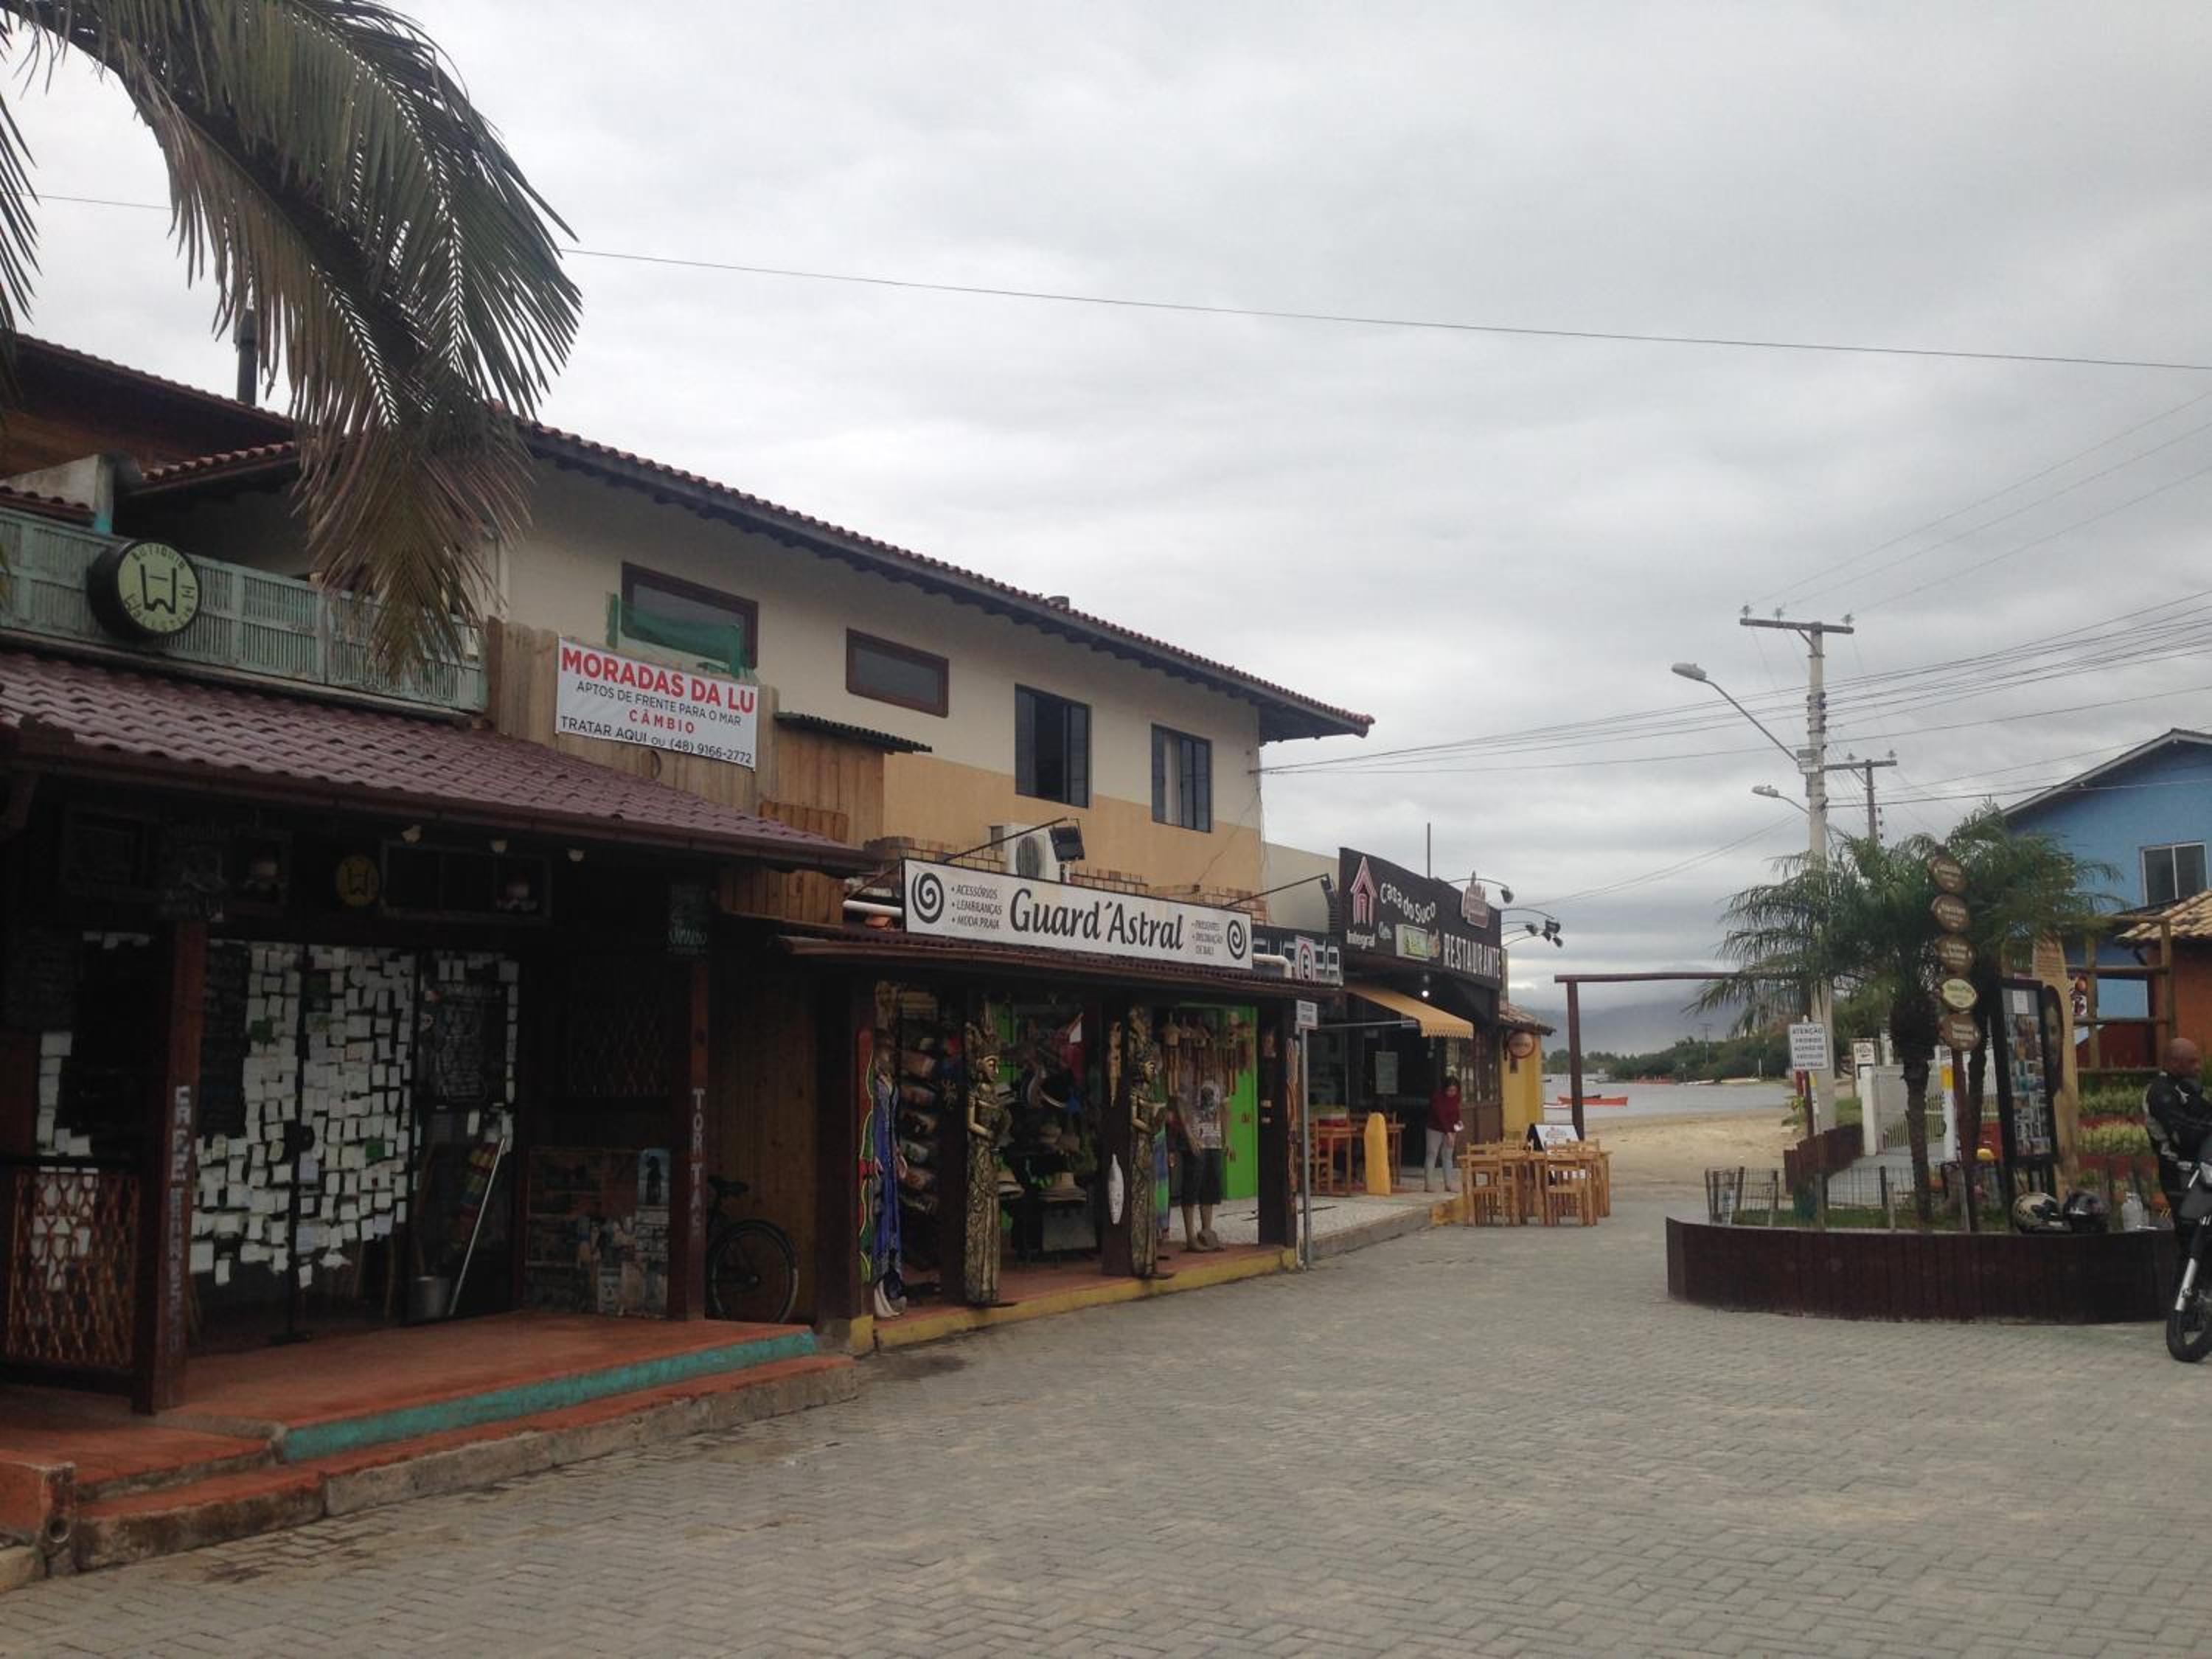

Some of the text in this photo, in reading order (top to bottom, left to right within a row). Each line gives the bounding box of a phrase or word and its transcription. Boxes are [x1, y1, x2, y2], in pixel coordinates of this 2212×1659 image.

[562, 647, 754, 713] MORADAS DA LU
[577, 681, 742, 726] APTOS DE FRENTE PARA O MAR
[629, 709, 695, 734] CÂMBIO
[560, 716, 612, 737] TRATAR
[616, 726, 647, 744] AQUI
[669, 739, 694, 754] (48)
[698, 742, 752, 764] 9166-2772
[1380, 882, 1436, 923] Casa do Suco
[1346, 929, 1375, 950] Integral
[1443, 932, 1501, 980] RESTAURANTE
